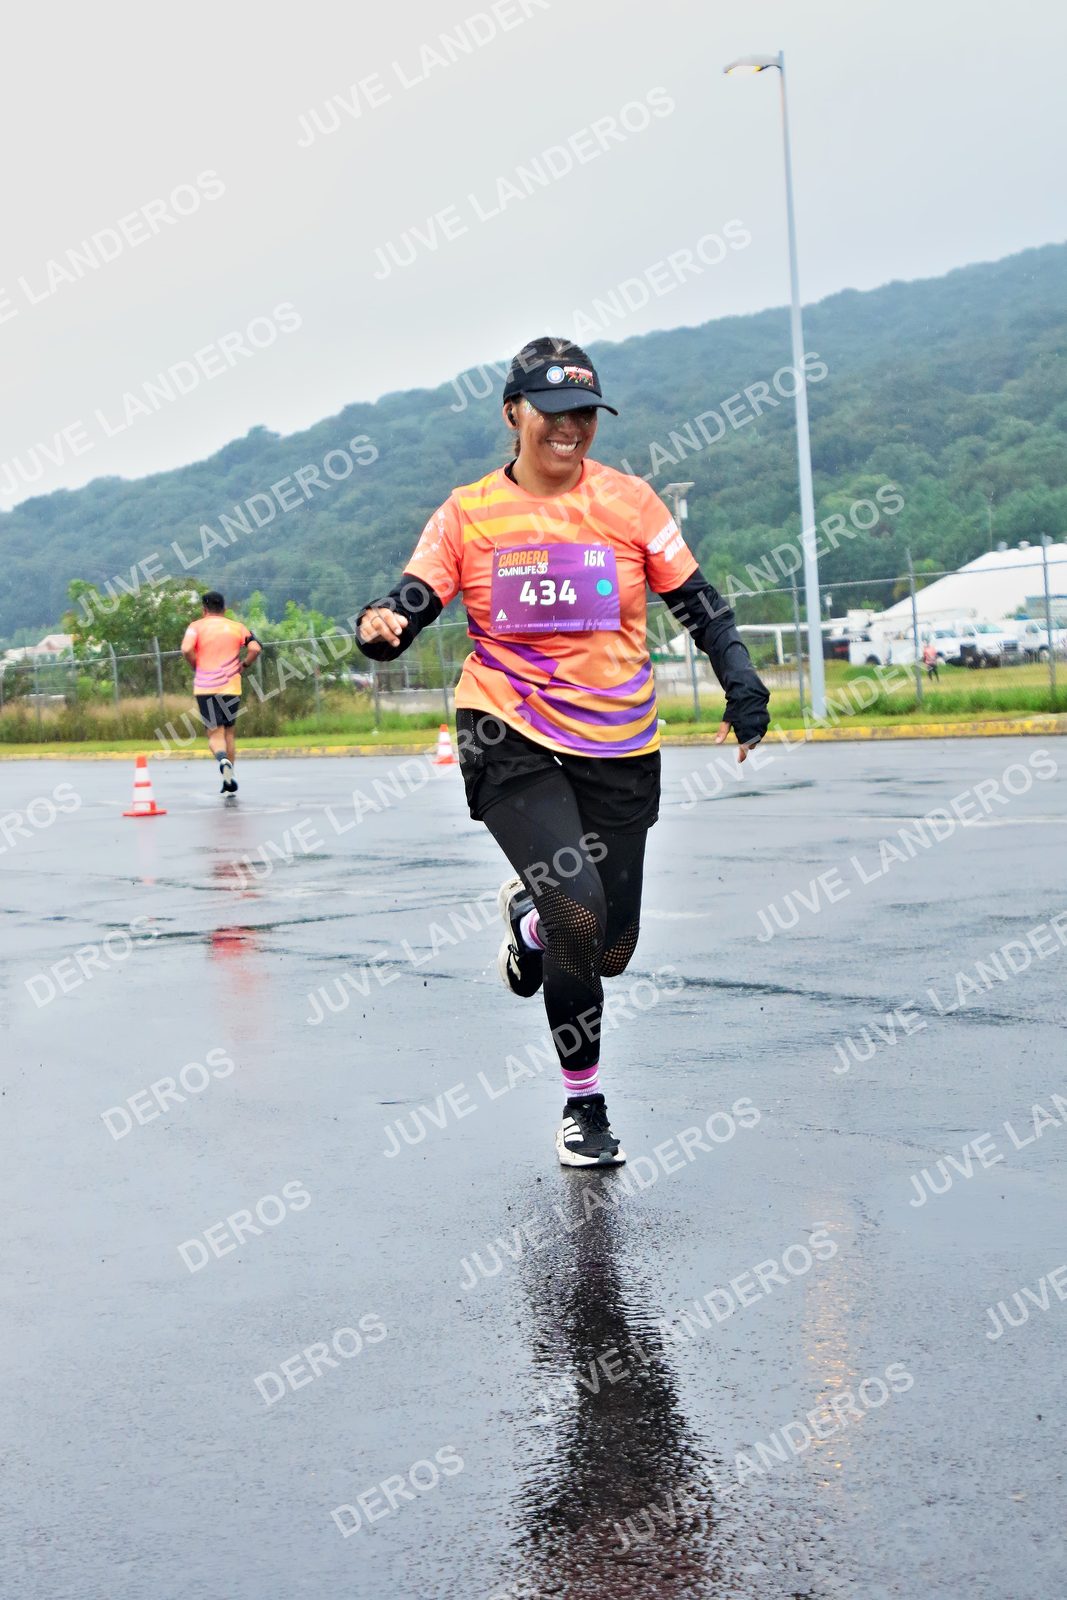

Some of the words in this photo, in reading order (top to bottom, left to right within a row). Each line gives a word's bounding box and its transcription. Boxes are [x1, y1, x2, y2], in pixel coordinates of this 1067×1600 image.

[498, 550, 549, 567] CARRERA
[497, 565, 537, 577] OMNILIFE
[519, 579, 577, 606] 434
